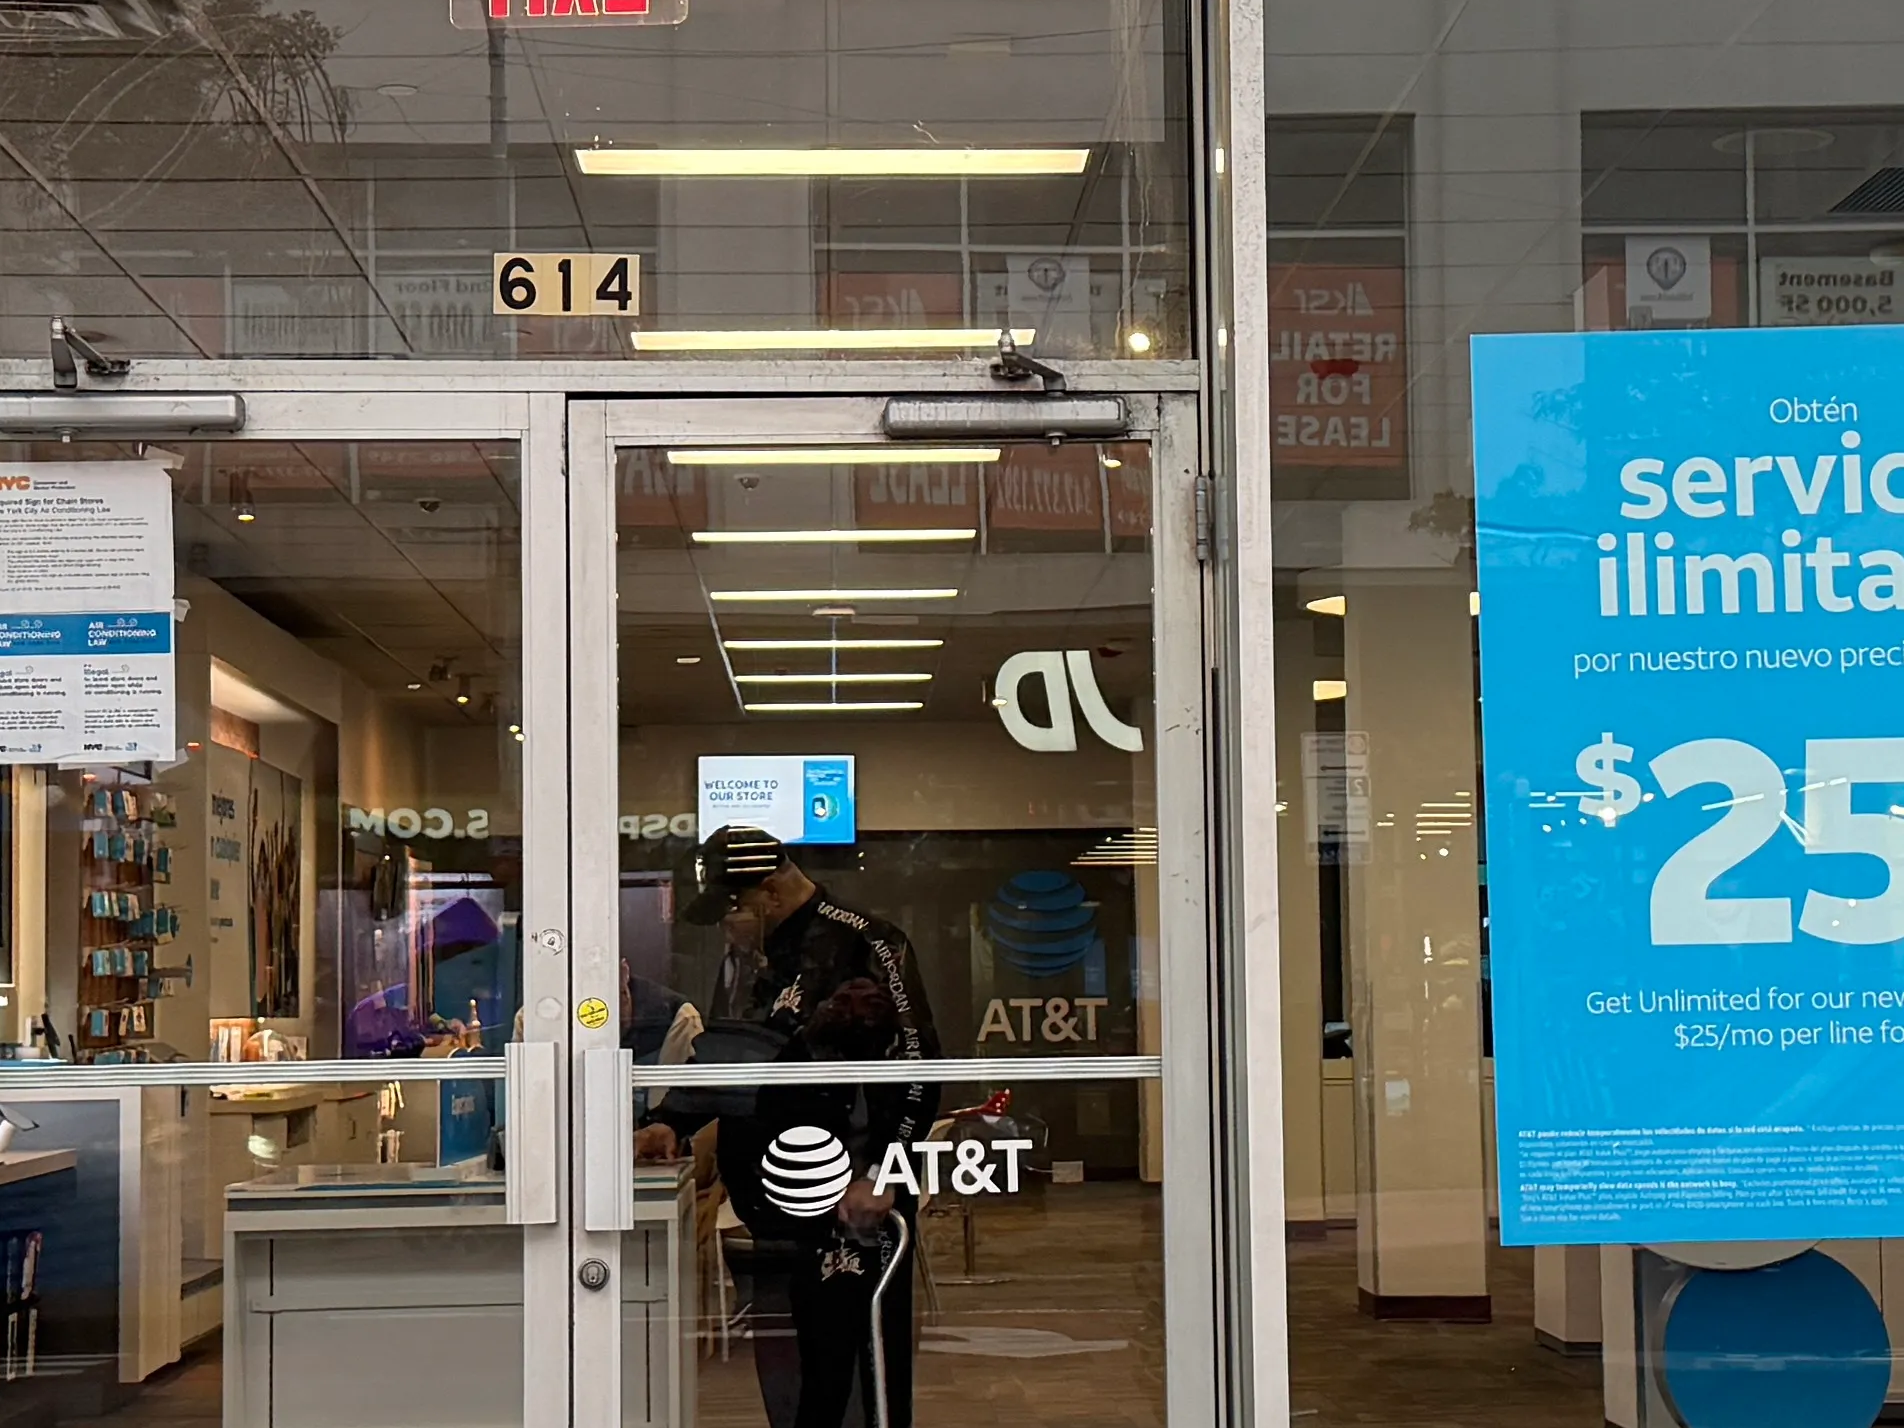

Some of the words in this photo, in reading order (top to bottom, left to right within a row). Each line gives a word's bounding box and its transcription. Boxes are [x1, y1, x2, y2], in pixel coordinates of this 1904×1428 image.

[500, 259, 631, 311] 614
[1769, 396, 1858, 425] Obtén
[88, 622, 104, 630] AIR
[88, 629, 156, 637] CONDITIONING
[88, 638, 107, 646] LAW
[1573, 651, 1622, 680] por
[1629, 645, 1738, 674] nuestro
[1746, 644, 1832, 670] nuevo
[705, 780, 760, 790] WELCOME
[763, 780, 779, 790] TO
[709, 791, 734, 801] OUR
[736, 791, 773, 801] STORE
[1586, 990, 1632, 1015] Get
[1639, 984, 1761, 1012] Unlimited
[1767, 984, 1803, 1010] for
[1810, 990, 1850, 1010] our
[977, 998, 1108, 1043] AT&T
[1673, 1021, 1772, 1050] $25/mo
[1780, 1024, 1823, 1052] per
[1830, 1019, 1873, 1045] line
[872, 1139, 1033, 1197] AT&T
